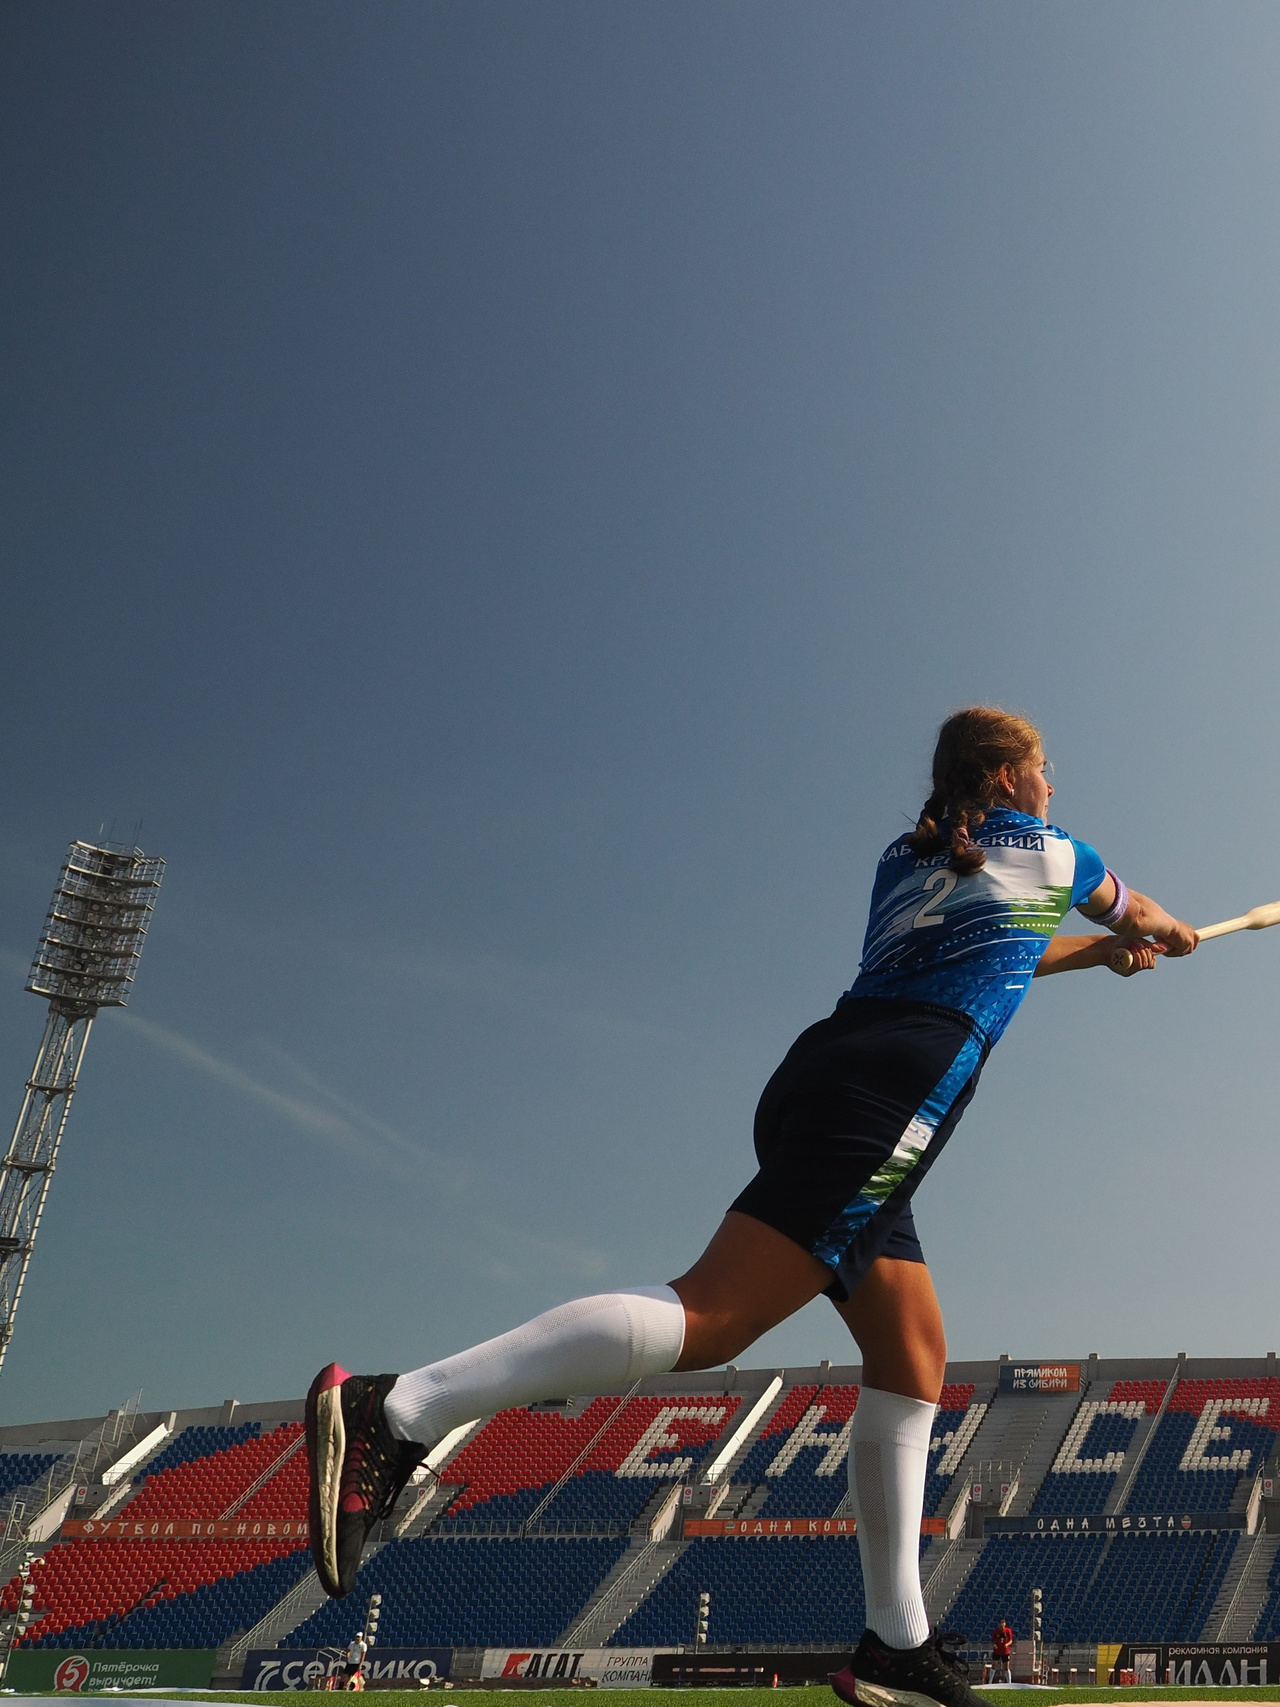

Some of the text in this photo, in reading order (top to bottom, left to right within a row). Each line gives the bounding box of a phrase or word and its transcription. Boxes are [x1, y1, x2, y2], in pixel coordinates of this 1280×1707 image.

[913, 867, 958, 929] 2
[1013, 1368, 1067, 1378] ПРЯМИКОМ
[1012, 1379, 1067, 1389] ИЗ СИБИРИ
[82, 1521, 308, 1535] ФУТБОЛ ПО-НОВОМ
[740, 1520, 792, 1533] ОДНА
[1036, 1517, 1089, 1531] ОДНА
[1168, 1646, 1268, 1656] рекламная компания
[92, 1661, 159, 1675] Пятёрочка
[525, 1653, 584, 1678] АГАТ
[606, 1656, 648, 1667] ГРУППА
[89, 1675, 157, 1688] выручает!
